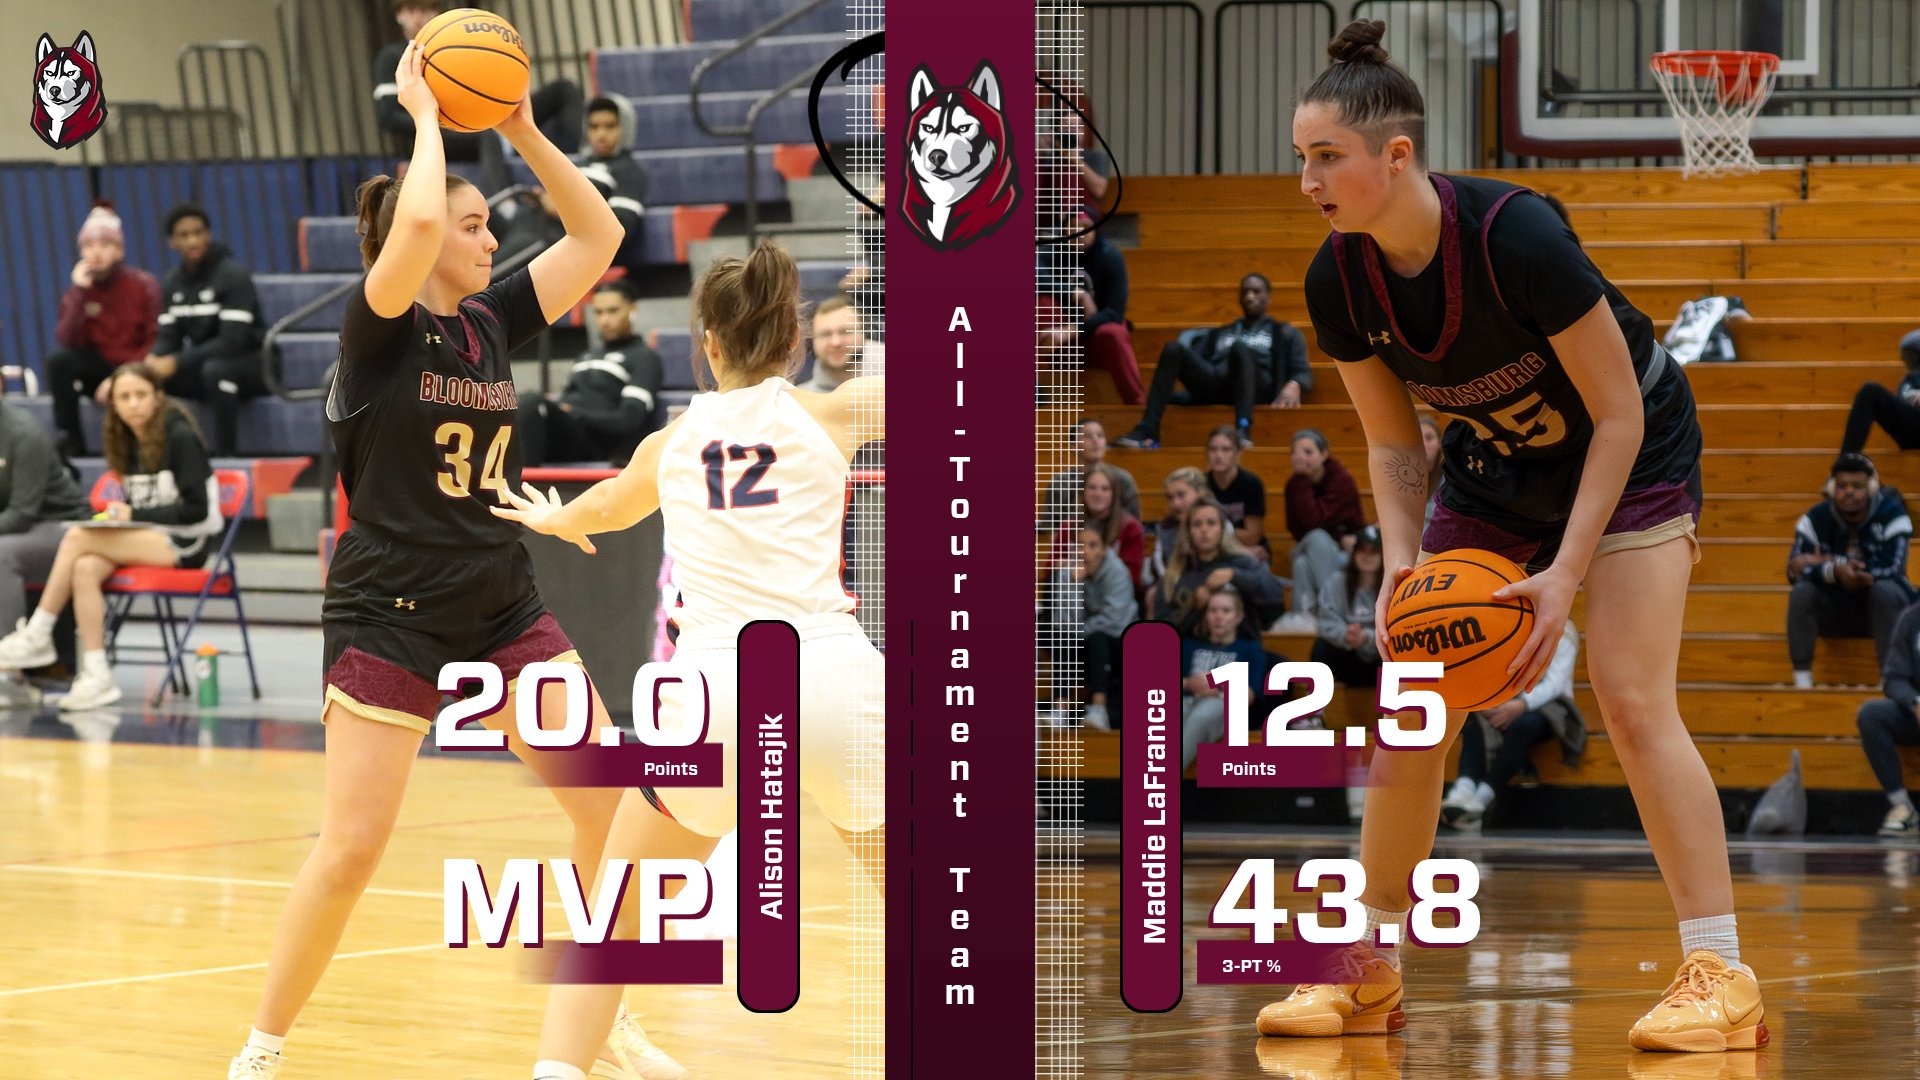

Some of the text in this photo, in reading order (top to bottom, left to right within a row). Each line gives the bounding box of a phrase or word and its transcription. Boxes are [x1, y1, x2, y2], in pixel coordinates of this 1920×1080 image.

[434, 421, 513, 504] 34
[700, 439, 779, 510] 12
[1391, 616, 1487, 656] Wilson
